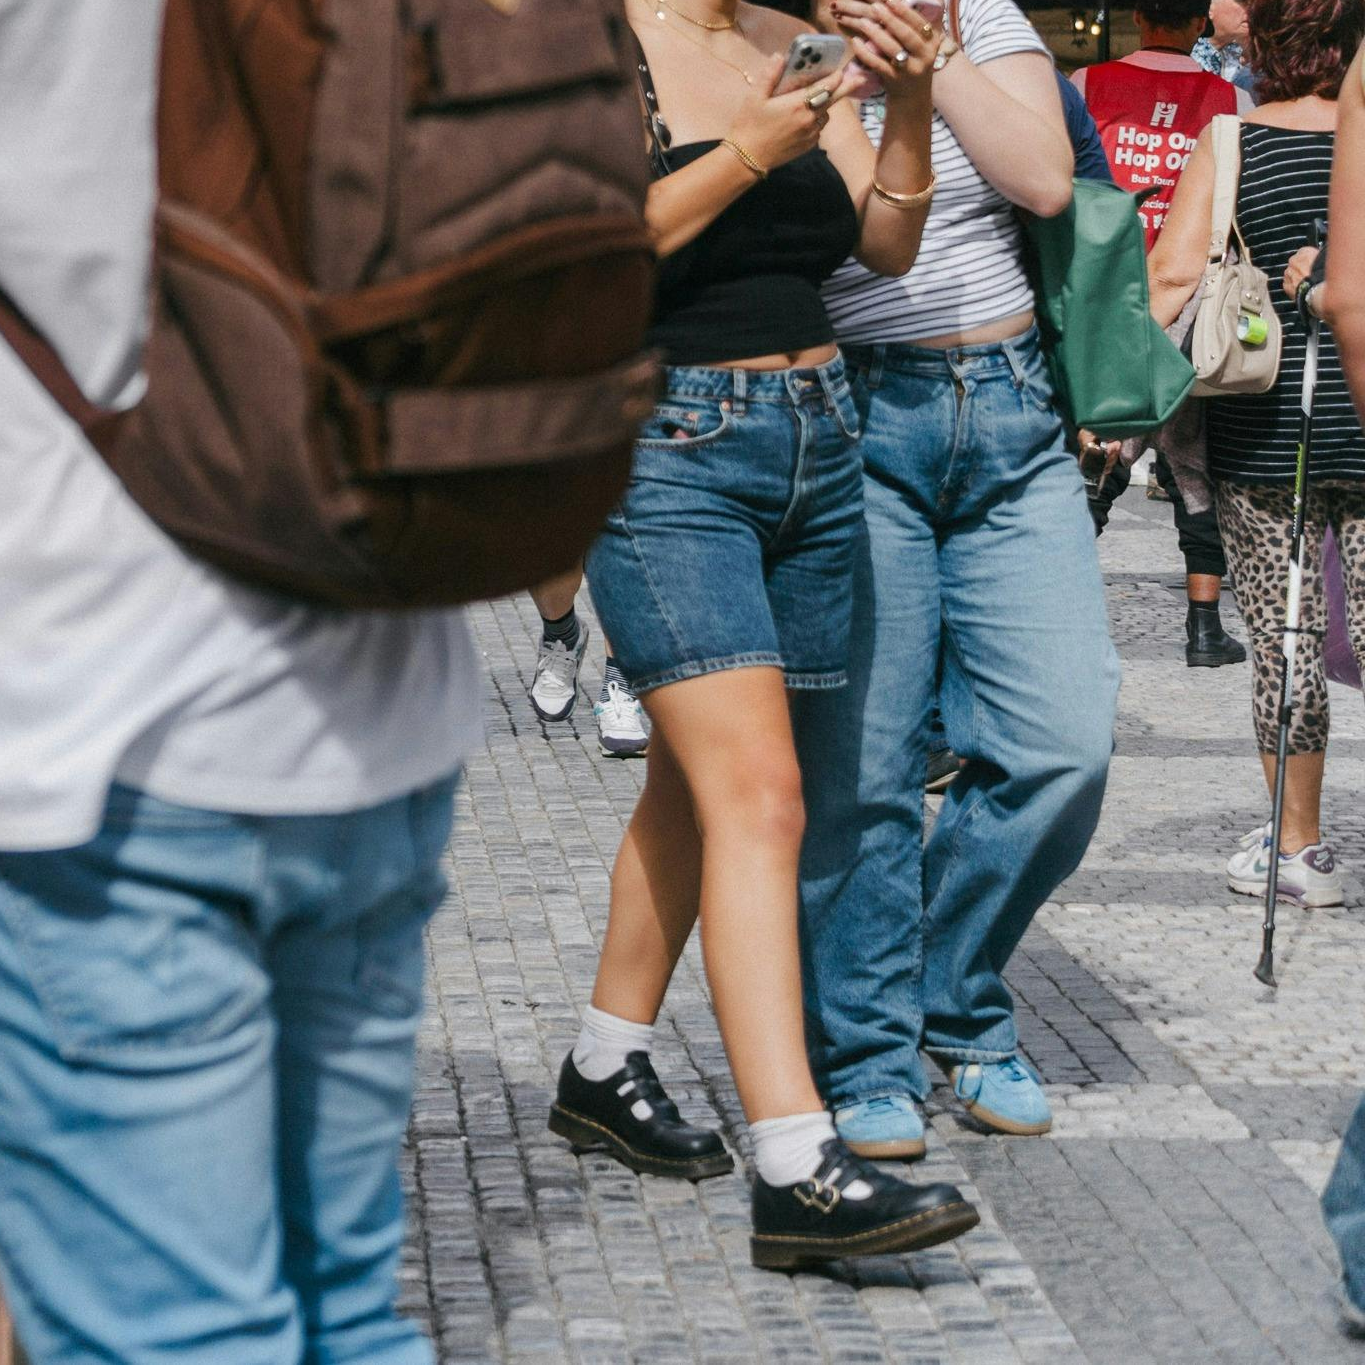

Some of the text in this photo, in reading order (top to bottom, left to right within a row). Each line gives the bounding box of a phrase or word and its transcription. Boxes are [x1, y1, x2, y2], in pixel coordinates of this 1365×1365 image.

[1117, 126, 1163, 152] Hop
[1114, 147, 1190, 172] Hop Of
[1131, 173, 1175, 186] Bus Tours
